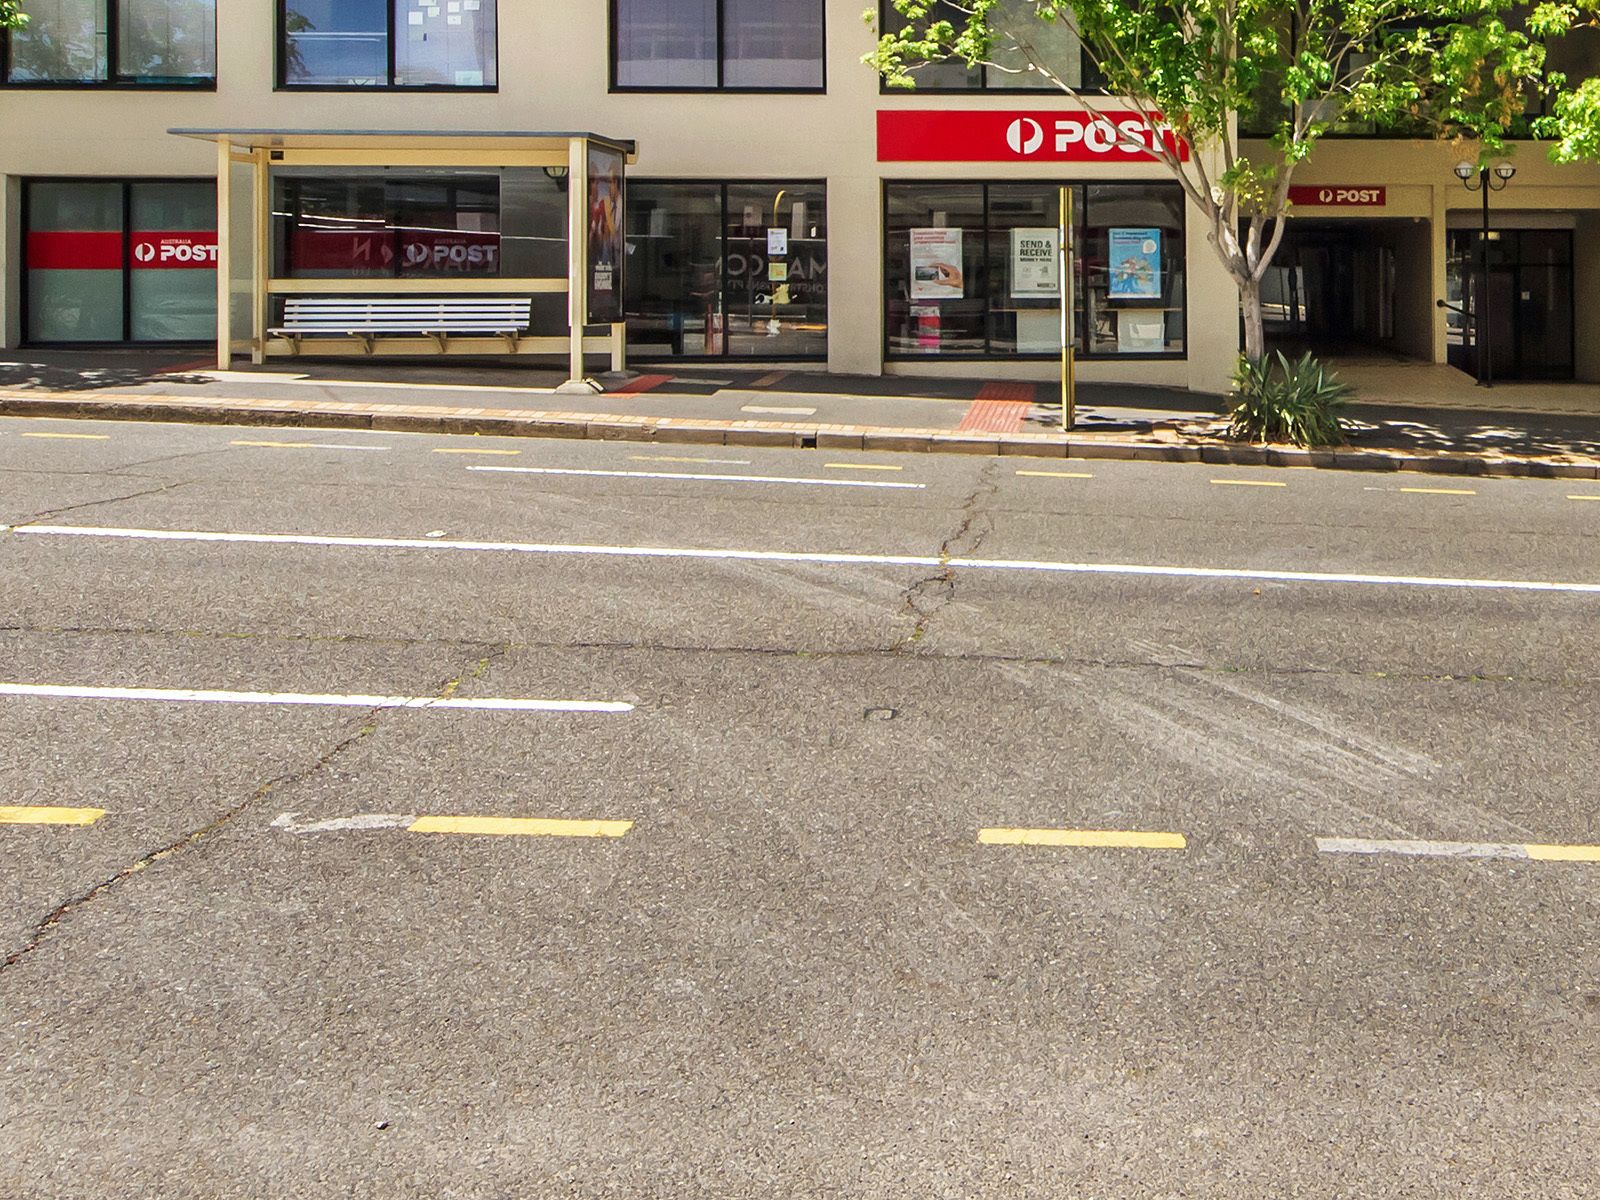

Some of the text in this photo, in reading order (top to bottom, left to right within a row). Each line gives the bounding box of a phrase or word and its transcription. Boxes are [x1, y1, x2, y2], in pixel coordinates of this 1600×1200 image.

[1055, 119, 1172, 154] POST
[1336, 189, 1380, 202] POST
[1020, 240, 1052, 248] SEND &
[160, 245, 218, 261] POST
[433, 245, 498, 262] POST
[1020, 249, 1052, 257] RECEIVE
